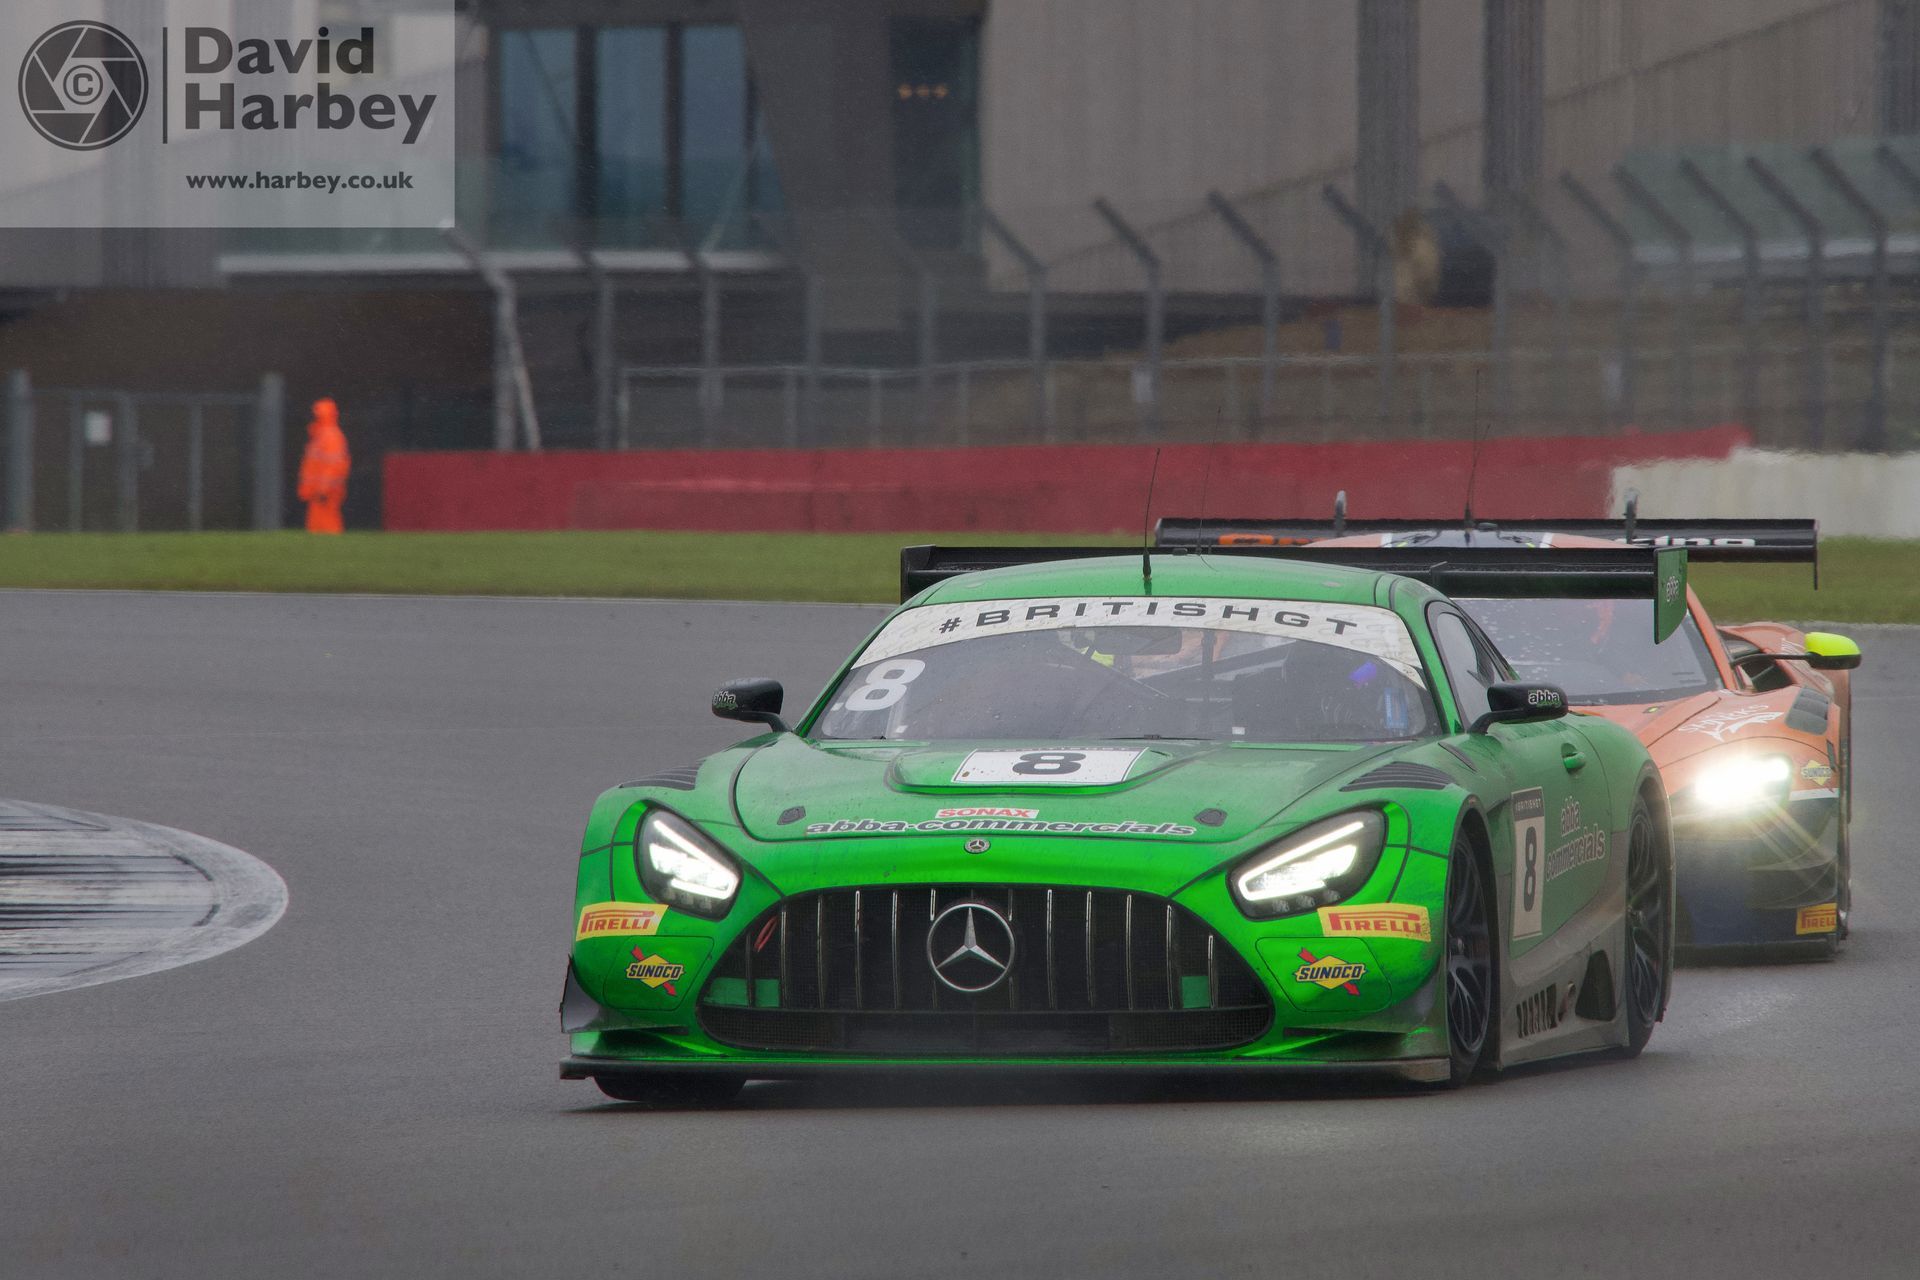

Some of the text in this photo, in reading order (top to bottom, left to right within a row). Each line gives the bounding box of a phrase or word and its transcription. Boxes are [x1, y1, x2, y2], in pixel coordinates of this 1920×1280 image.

[939, 602, 1357, 635] #BRITISHGT
[845, 659, 926, 711] 8
[1528, 689, 1560, 705] abba
[1012, 752, 1087, 775] 8
[939, 808, 1029, 818] SONAX
[1523, 826, 1537, 912] 8
[580, 909, 655, 934] PIRELLI
[1328, 911, 1421, 934] PIRELLI
[628, 964, 682, 979] SUNOCO
[1299, 965, 1364, 980] SUNOCO
